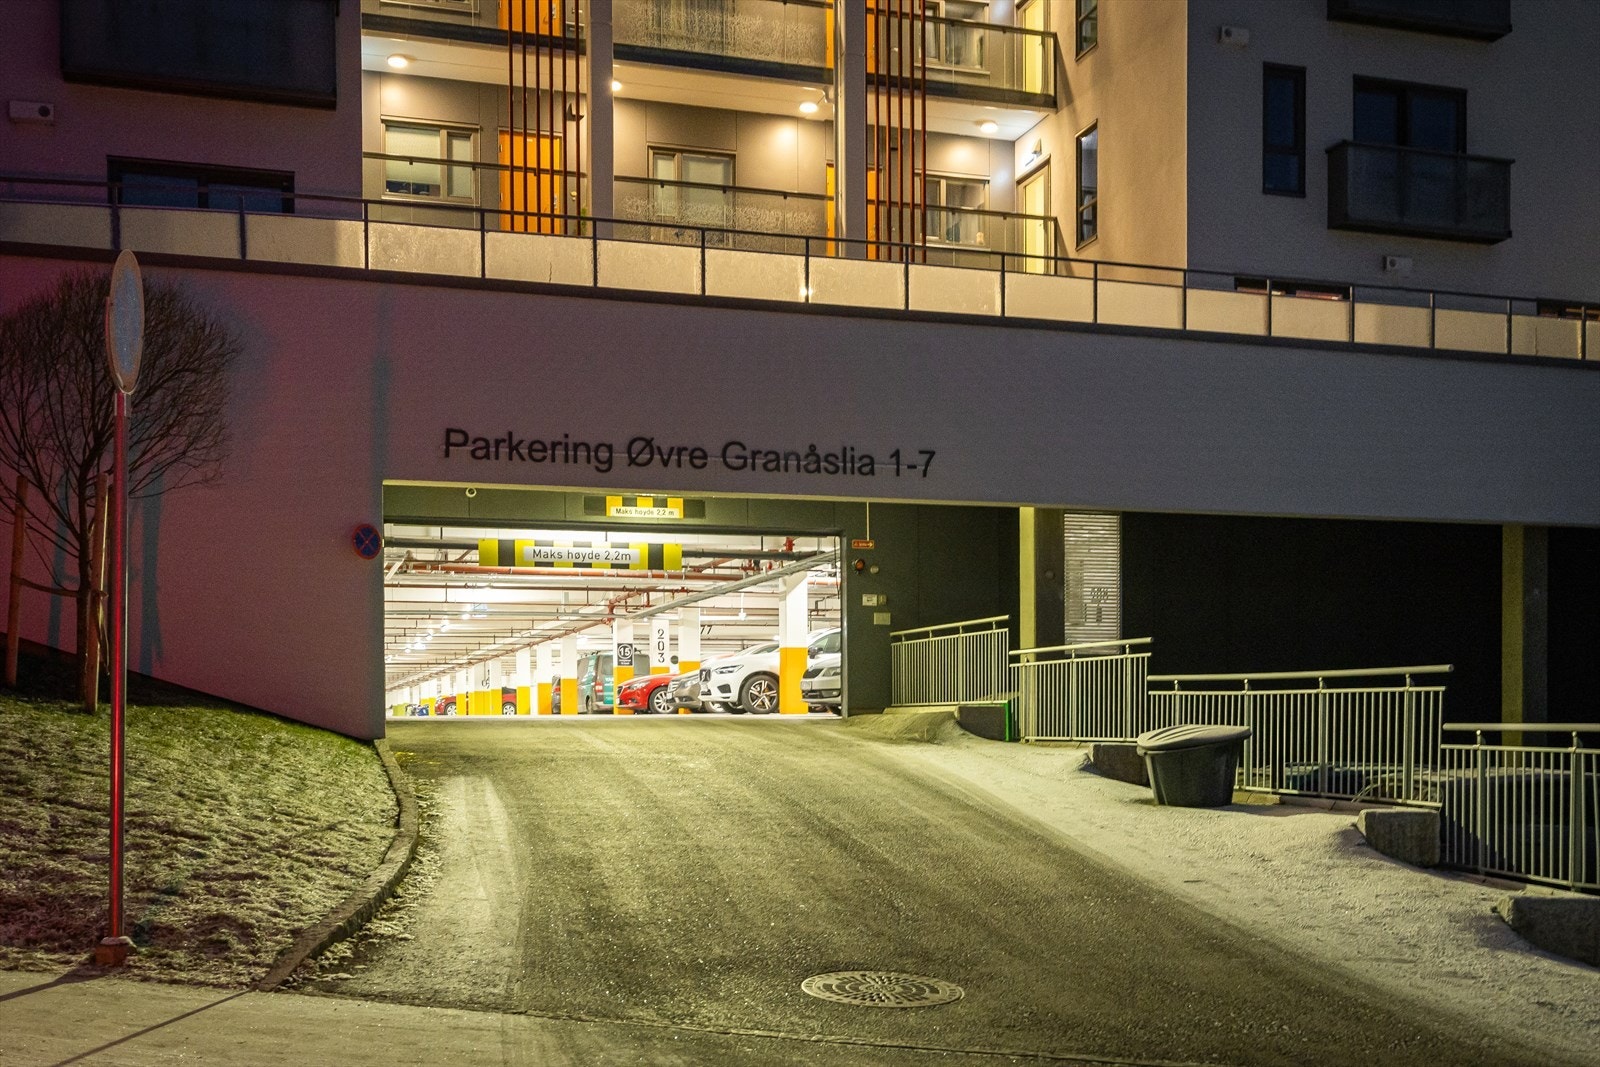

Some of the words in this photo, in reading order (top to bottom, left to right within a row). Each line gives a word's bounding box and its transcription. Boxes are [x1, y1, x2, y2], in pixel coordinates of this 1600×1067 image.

[444, 427, 614, 474] Parkering
[626, 436, 708, 469] Øvre
[721, 439, 877, 476] Granåslia
[888, 449, 936, 478] 1-7
[615, 508, 633, 516] Maks
[635, 509, 655, 517] høyde
[532, 548, 563, 559] Maks
[567, 549, 601, 562] høyde
